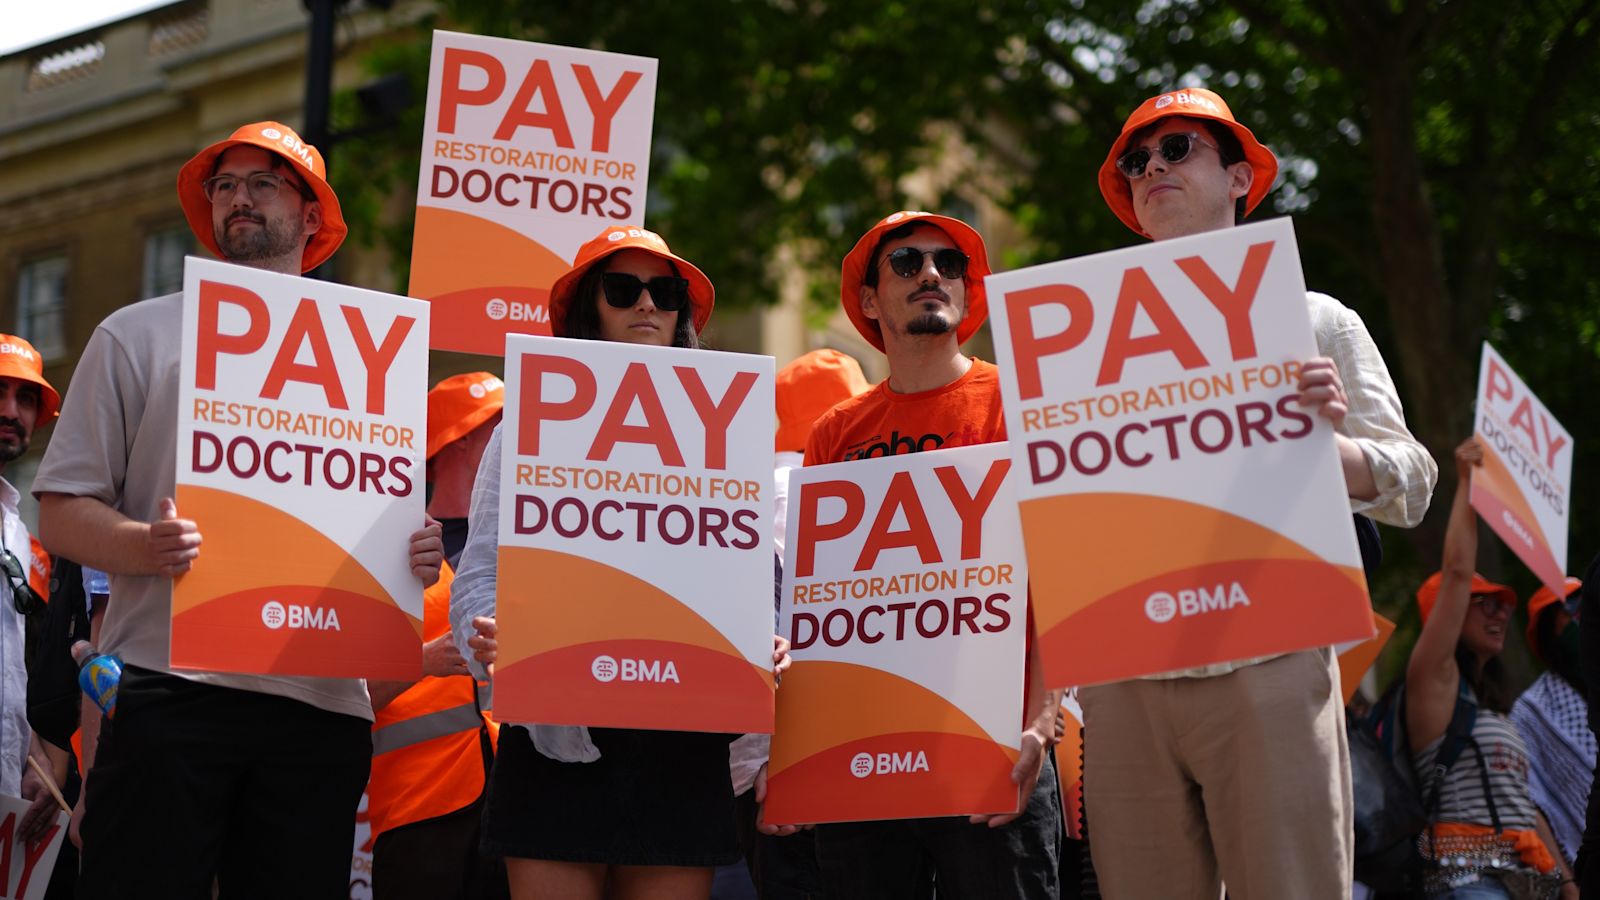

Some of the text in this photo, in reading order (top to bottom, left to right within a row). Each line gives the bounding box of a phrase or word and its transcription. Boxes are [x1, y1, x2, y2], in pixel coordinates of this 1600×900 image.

[437, 47, 643, 153] PAY
[1176, 93, 1219, 112] BMA
[281, 134, 313, 172] BMA
[434, 139, 636, 181] RESTORATION FOR
[430, 164, 633, 220] DOCTORS
[195, 279, 416, 416] PAY
[1004, 240, 1276, 402] PAY
[1, 343, 34, 362] BMA
[193, 398, 415, 449] RESTORATION FOR
[517, 352, 760, 470] PAY
[1022, 360, 1303, 432] RESTORATION FOR
[1485, 355, 1567, 470] PAY
[191, 430, 413, 498] DOCTORS
[1027, 394, 1314, 485] DOCTORS
[1482, 415, 1563, 516] DOCTORS
[515, 464, 760, 502] RESTORATION FOR
[514, 494, 760, 550] DOCTORS
[794, 458, 1012, 578] PAY
[793, 563, 1014, 605] RESTORATION FOR
[1179, 582, 1251, 617] BMA
[288, 604, 341, 631] BMA
[790, 593, 1011, 651] DOCTORS
[621, 659, 680, 683] BMA
[876, 751, 929, 775] BMA
